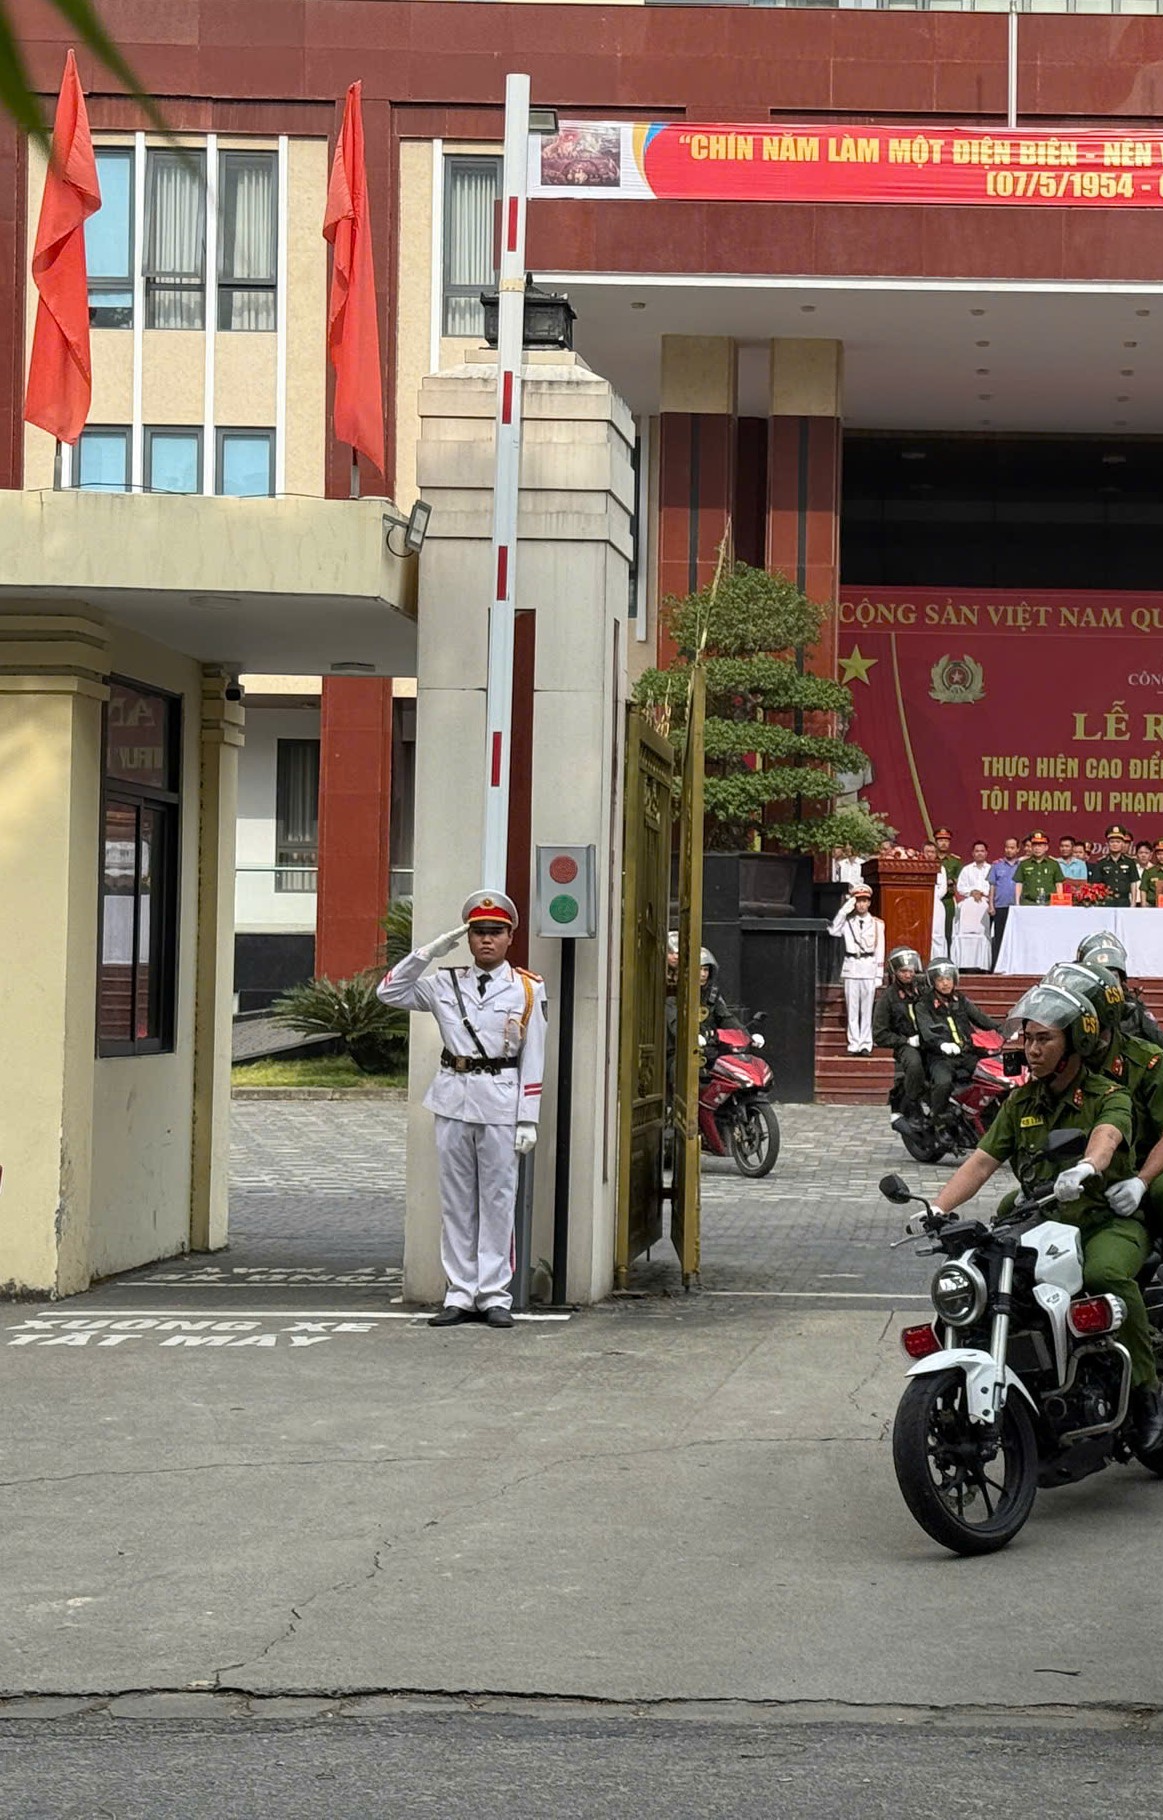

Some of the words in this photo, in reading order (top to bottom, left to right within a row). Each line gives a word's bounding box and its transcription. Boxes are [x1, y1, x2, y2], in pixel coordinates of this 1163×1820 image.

[762, 132, 819, 162] NĂM
[827, 134, 880, 163] LÀM
[887, 135, 944, 168] MỘT
[952, 136, 1011, 170] ĐIỆN
[1019, 137, 1078, 166] BIÊN
[1103, 138, 1151, 167] NÊN
[839, 598, 918, 628] CỘNG
[925, 598, 979, 626] SẢN
[987, 601, 1053, 632] VIỆT
[1059, 606, 1124, 628] NAM
[1072, 700, 1131, 741] LỄ
[982, 755, 1030, 782] THỰC
[1036, 753, 1079, 783] HIỆN
[1085, 758, 1123, 779] CAO
[980, 785, 1009, 815] TỘI
[1016, 790, 1078, 816] PHẠM,
[1084, 791, 1102, 812] VI
[1109, 791, 1163, 817] PHẠM
[5, 1317, 263, 1331] XUỐNG
[280, 1321, 379, 1333] XE
[7, 1330, 143, 1347] TẮT
[158, 1333, 332, 1347] MÁY
